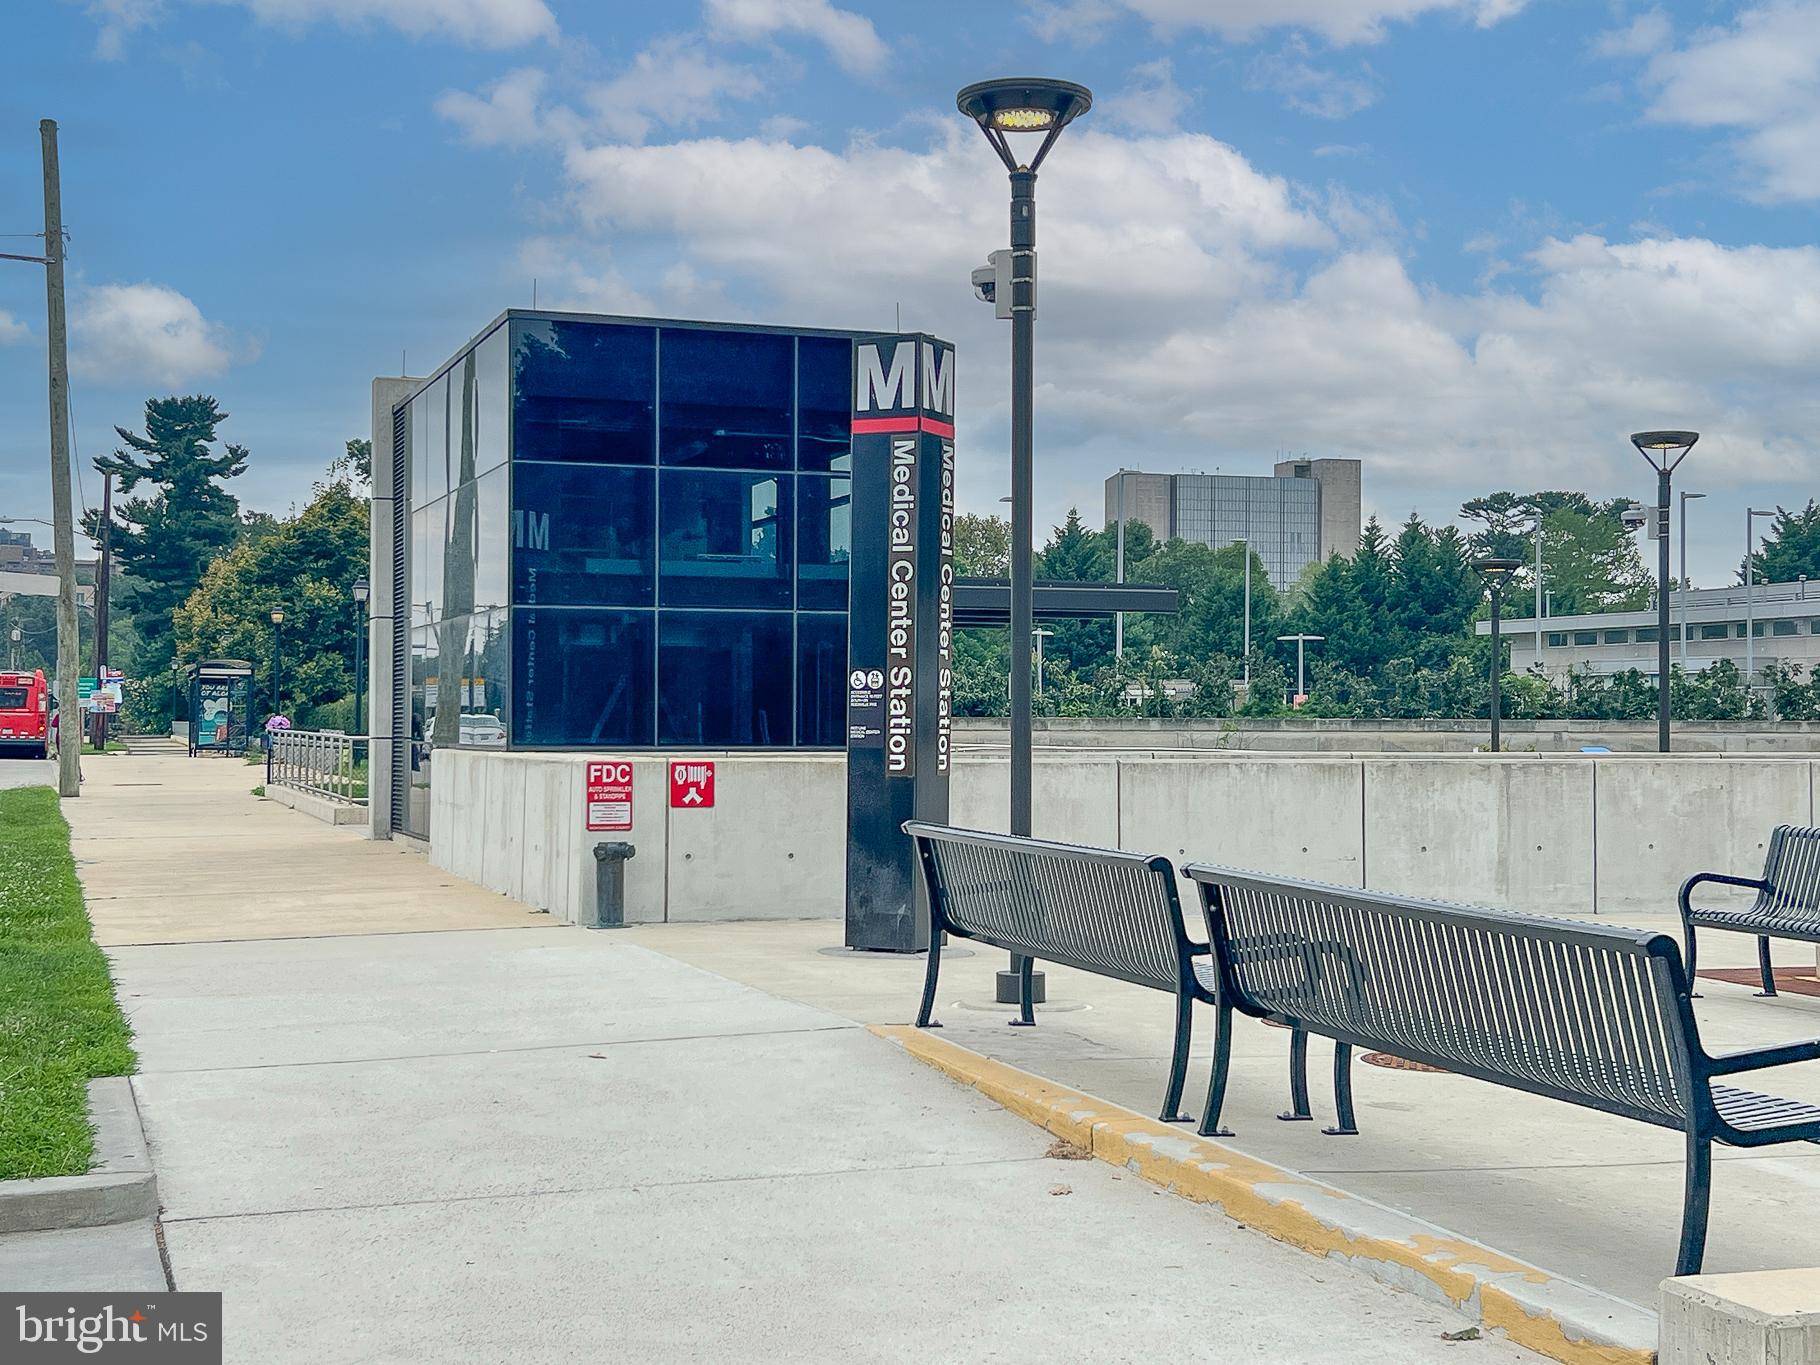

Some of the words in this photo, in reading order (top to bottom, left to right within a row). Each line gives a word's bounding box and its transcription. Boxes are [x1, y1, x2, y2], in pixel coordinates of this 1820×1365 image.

[856, 341, 916, 412] M
[922, 341, 954, 417] M
[892, 439, 916, 552] Medical
[941, 444, 954, 556] Medical
[890, 559, 914, 659] Center
[939, 563, 953, 660] Center
[888, 666, 913, 772] Station
[937, 667, 951, 770] Station
[588, 785, 603, 793] AUTO
[603, 785, 632, 793] SPRINKLER
[590, 764, 631, 783] FDC
[599, 792, 626, 800] STANDPIPE
